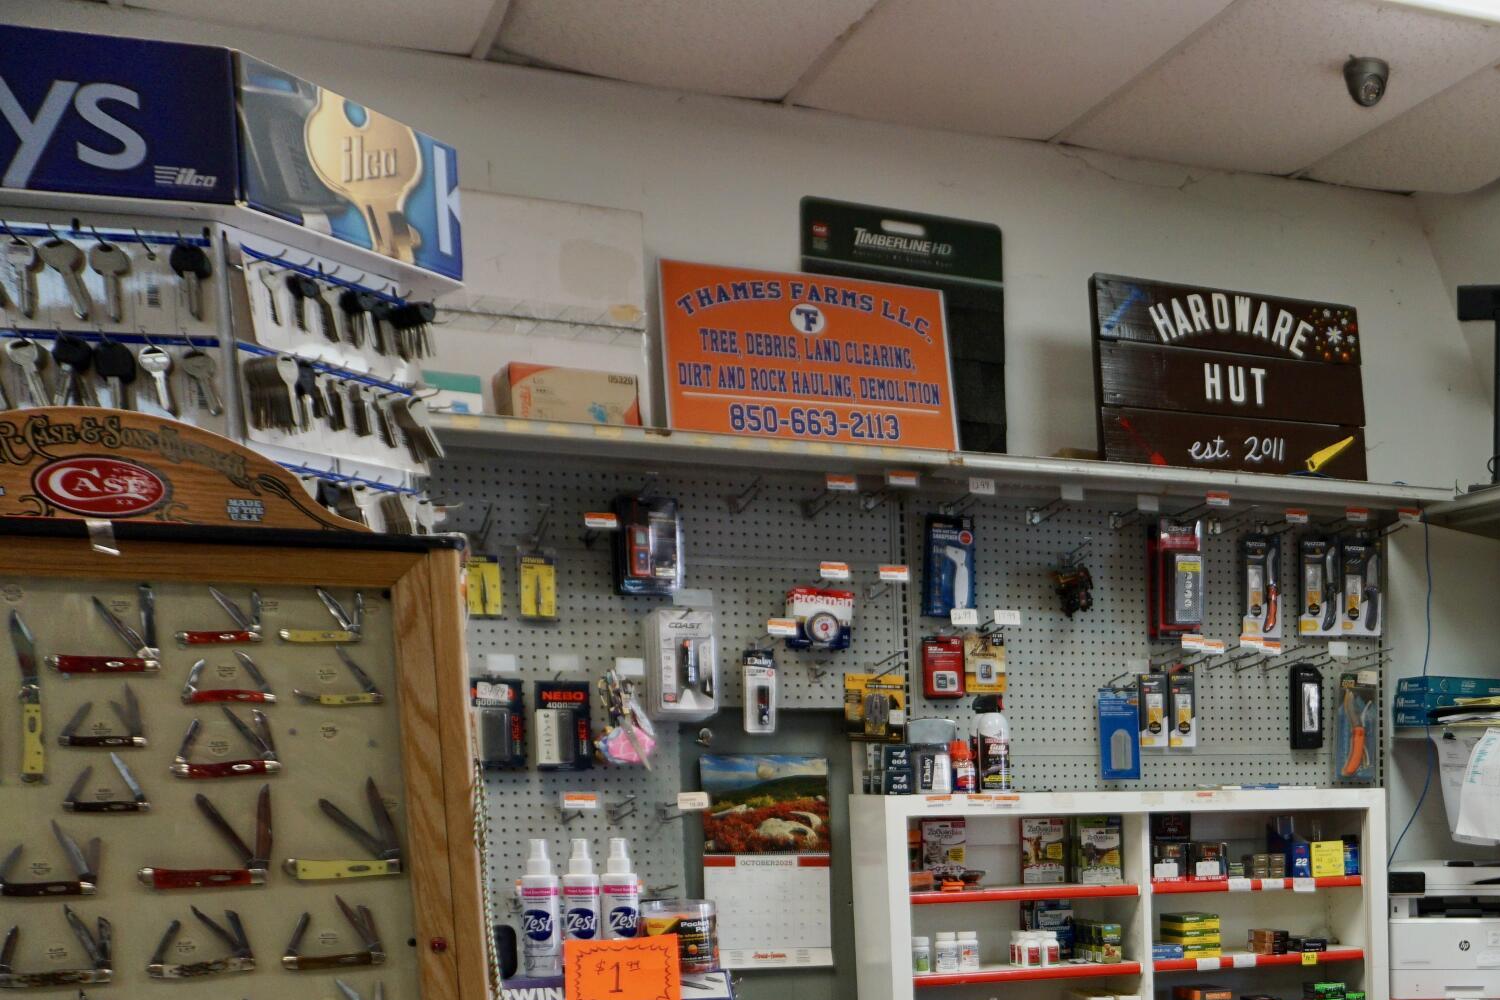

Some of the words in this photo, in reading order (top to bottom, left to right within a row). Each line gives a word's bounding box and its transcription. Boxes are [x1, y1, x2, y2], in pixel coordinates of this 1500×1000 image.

[344, 136, 397, 182] ilco
[175, 167, 217, 188] ilco
[853, 227, 932, 254] TIMBERLINE
[932, 243, 953, 256] HD
[677, 281, 782, 316] THAMES
[790, 282, 873, 312] FARMS
[882, 301, 934, 344] LLC.
[1149, 293, 1314, 358] HARDWARE
[699, 328, 742, 358] TREE,
[746, 333, 801, 361] DEBRIS,
[804, 339, 841, 363] LAND
[678, 363, 711, 386] DIRT
[718, 366, 745, 389] AND
[750, 368, 786, 392] ROCK
[791, 372, 857, 405] HAULING,
[859, 377, 941, 405] DEMOLITION
[1204, 363, 1266, 405] HUT
[729, 404, 900, 441] 850-663-2113
[1187, 435, 1230, 460] est.
[1244, 436, 1285, 461] 2011
[50, 466, 149, 502] CASE
[228, 500, 262, 508] MADE
[242, 507, 265, 515] THE
[668, 622, 702, 630] COAST
[541, 691, 585, 701] NEBO
[1295, 858, 1308, 866] 22
[524, 914, 552, 932] Zest
[567, 913, 596, 931] Zest
[609, 911, 639, 930] Zest
